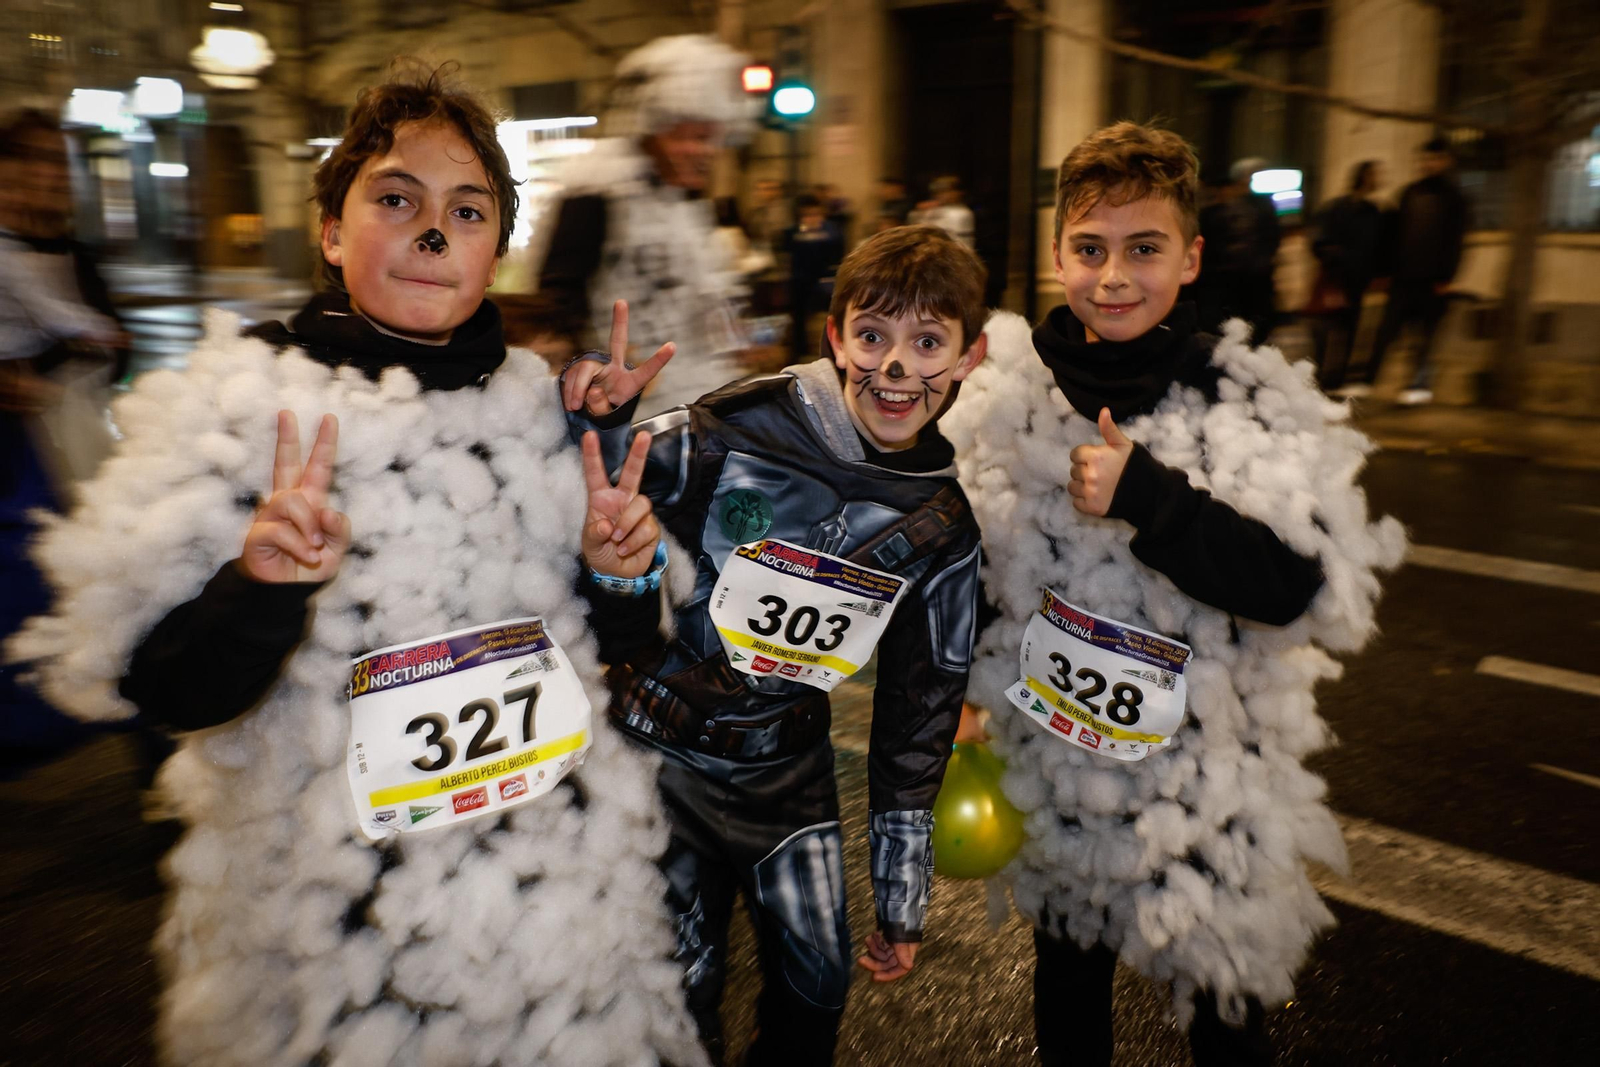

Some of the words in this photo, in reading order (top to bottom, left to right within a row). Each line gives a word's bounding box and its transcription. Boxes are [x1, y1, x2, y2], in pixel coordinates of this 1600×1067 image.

[757, 552, 815, 578] NOCTURNA
[761, 541, 819, 569] CARRERA
[841, 573, 858, 583] Paseo
[747, 595, 851, 652] 303
[1047, 609, 1092, 640] NOCTURNA
[487, 639, 506, 648] Paseo
[751, 640, 773, 653] JAVIER
[772, 646, 797, 660] ROMERO
[796, 652, 821, 663] SERRANO
[1123, 638, 1142, 649] Paseo
[353, 659, 370, 696] 33
[369, 640, 452, 675] CARRERA
[370, 656, 455, 689] NOCTURNA
[1047, 651, 1144, 726] 328
[1056, 697, 1074, 714] EMILIO
[1072, 706, 1092, 724] PEREZ
[405, 680, 544, 772] 327
[359, 762, 368, 774] SUB
[440, 768, 480, 789] ALBERTO
[481, 760, 508, 778] PEREZ
[508, 750, 538, 769] BUSTOS
